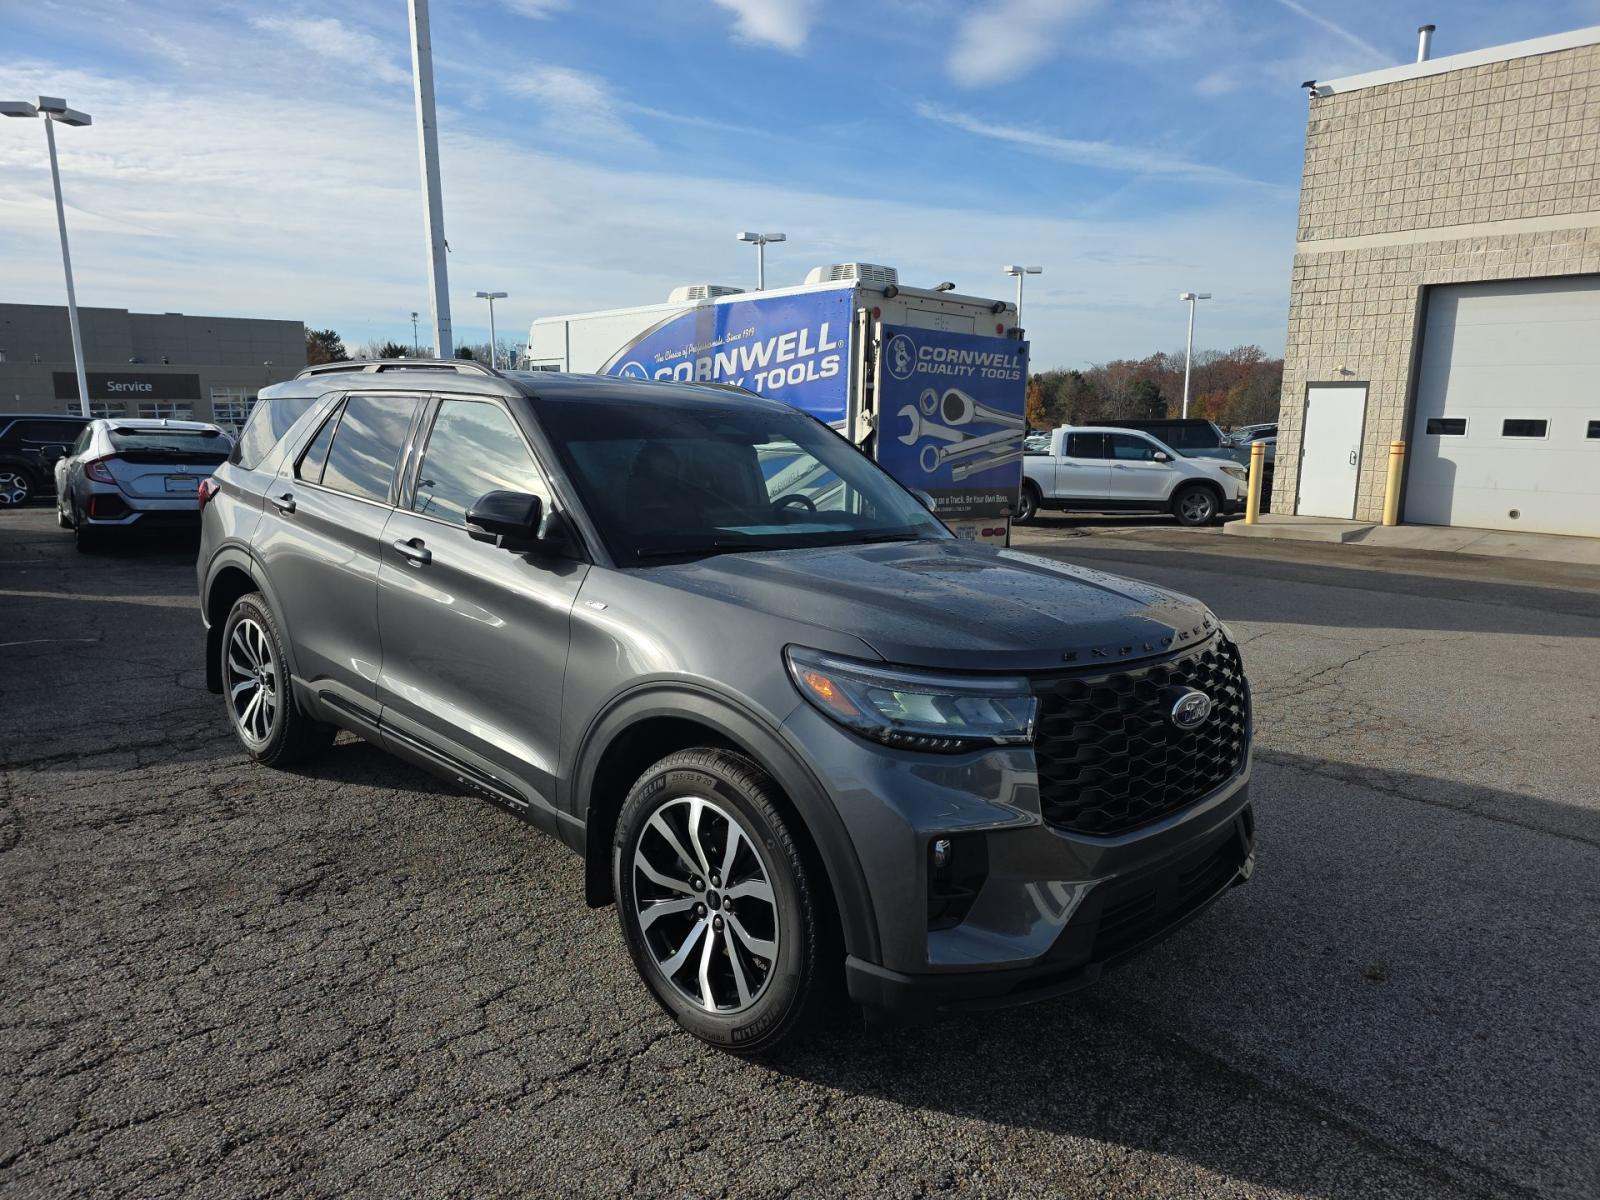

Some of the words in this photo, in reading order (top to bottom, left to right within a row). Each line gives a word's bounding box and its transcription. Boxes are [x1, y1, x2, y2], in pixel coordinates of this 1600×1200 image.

[654, 322, 837, 383] CORNWELL
[918, 345, 1021, 369] CORNWELL
[754, 354, 841, 393] TOOLS
[917, 362, 976, 377] QUALITY
[981, 367, 1021, 381] TOOLS
[107, 381, 153, 393] Service
